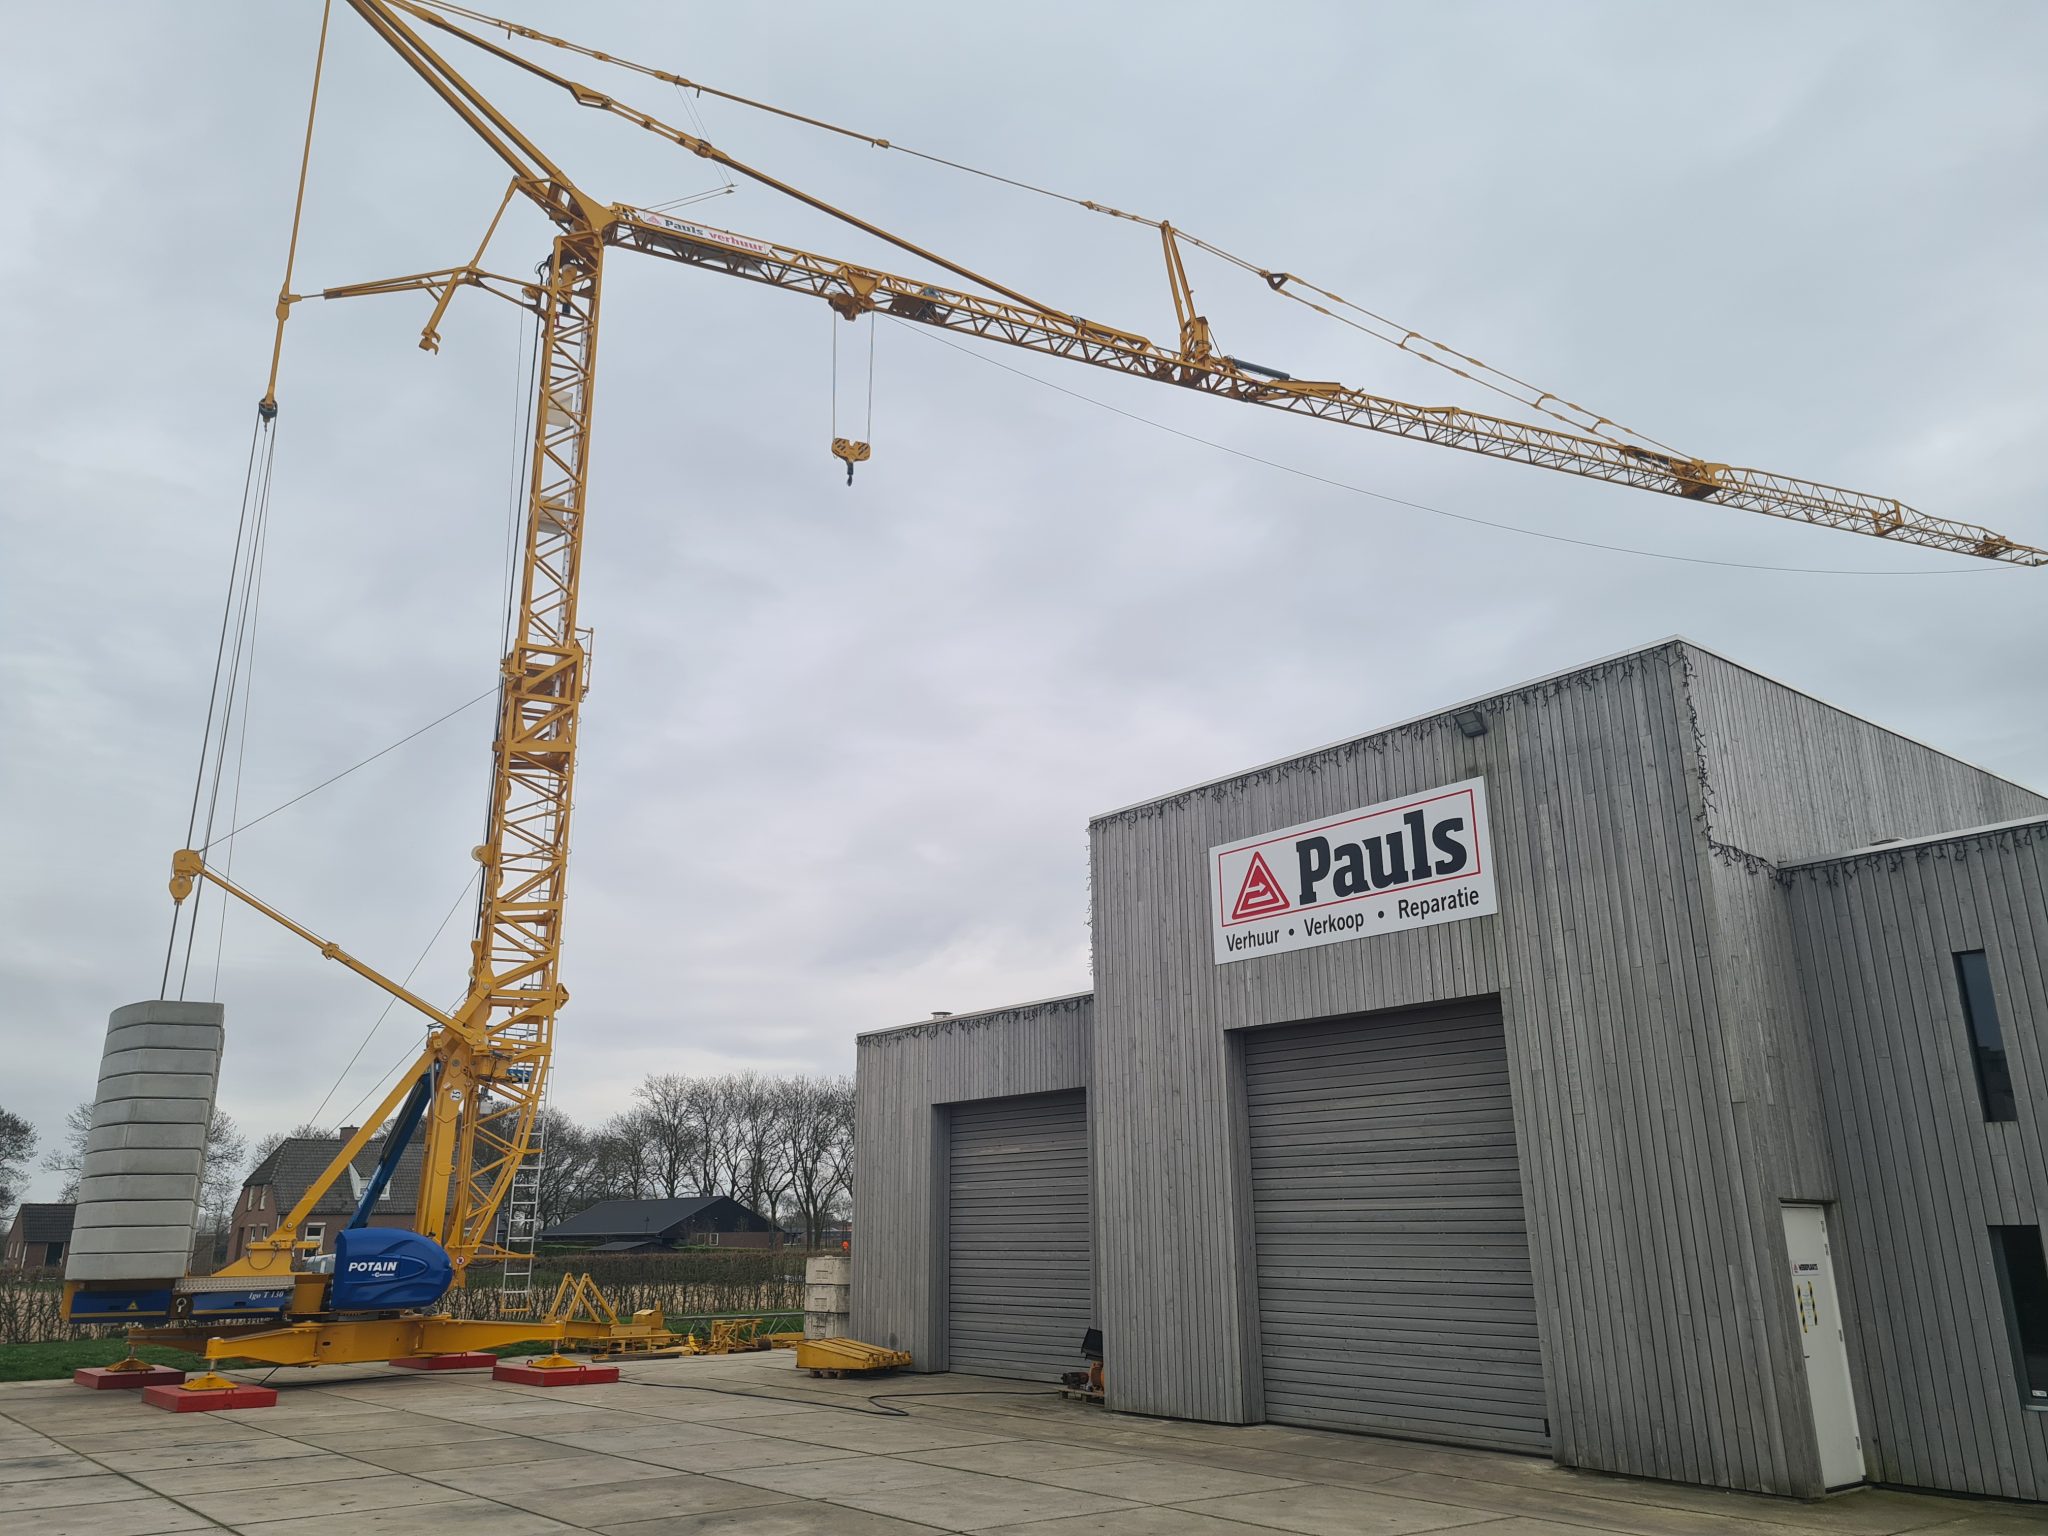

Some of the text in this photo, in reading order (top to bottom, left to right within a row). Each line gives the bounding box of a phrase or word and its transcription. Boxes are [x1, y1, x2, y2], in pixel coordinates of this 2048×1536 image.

[664, 219, 764, 251] Pauls verhuur
[1295, 809, 1468, 905] Pauls
[1226, 886, 1480, 952] Verhuur Verkoop Reparatie
[348, 1261, 398, 1272] POTAIN
